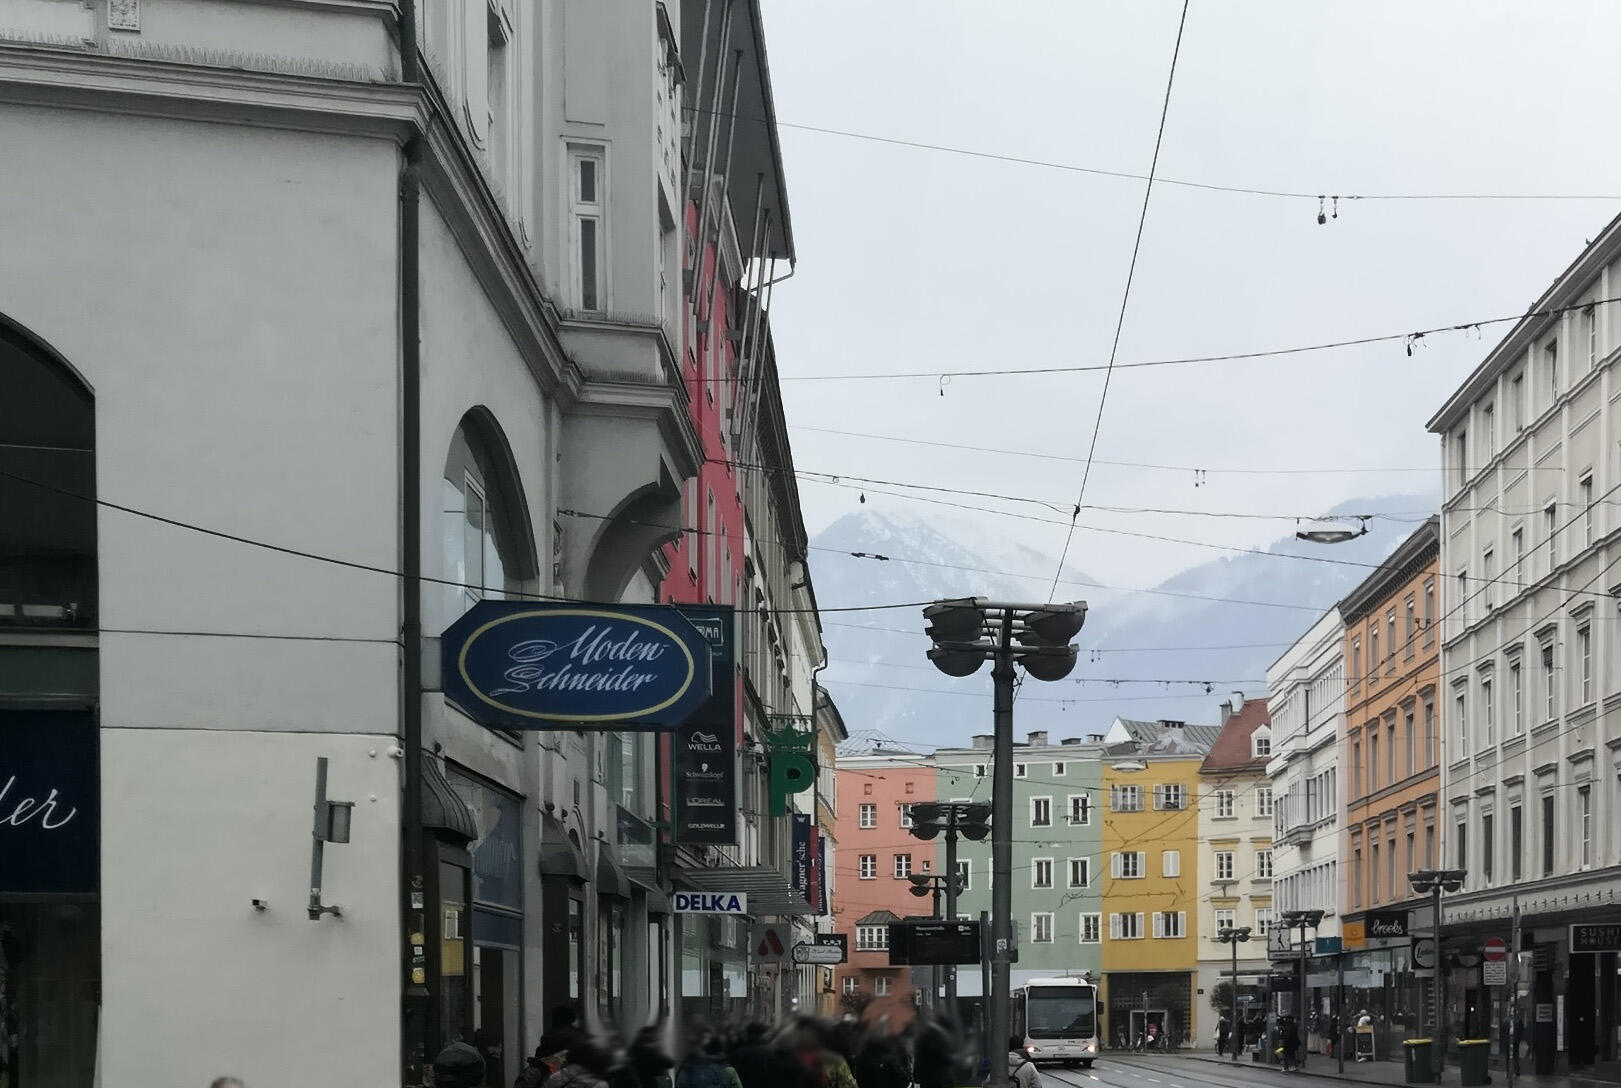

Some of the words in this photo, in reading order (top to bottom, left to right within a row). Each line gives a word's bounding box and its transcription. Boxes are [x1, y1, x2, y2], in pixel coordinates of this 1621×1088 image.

[488, 664, 658, 697] Schneider
[687, 743, 722, 751] WELLA
[675, 893, 742, 912] DELKA
[1370, 919, 1405, 935] brooks
[1580, 927, 1621, 938] SUSHI
